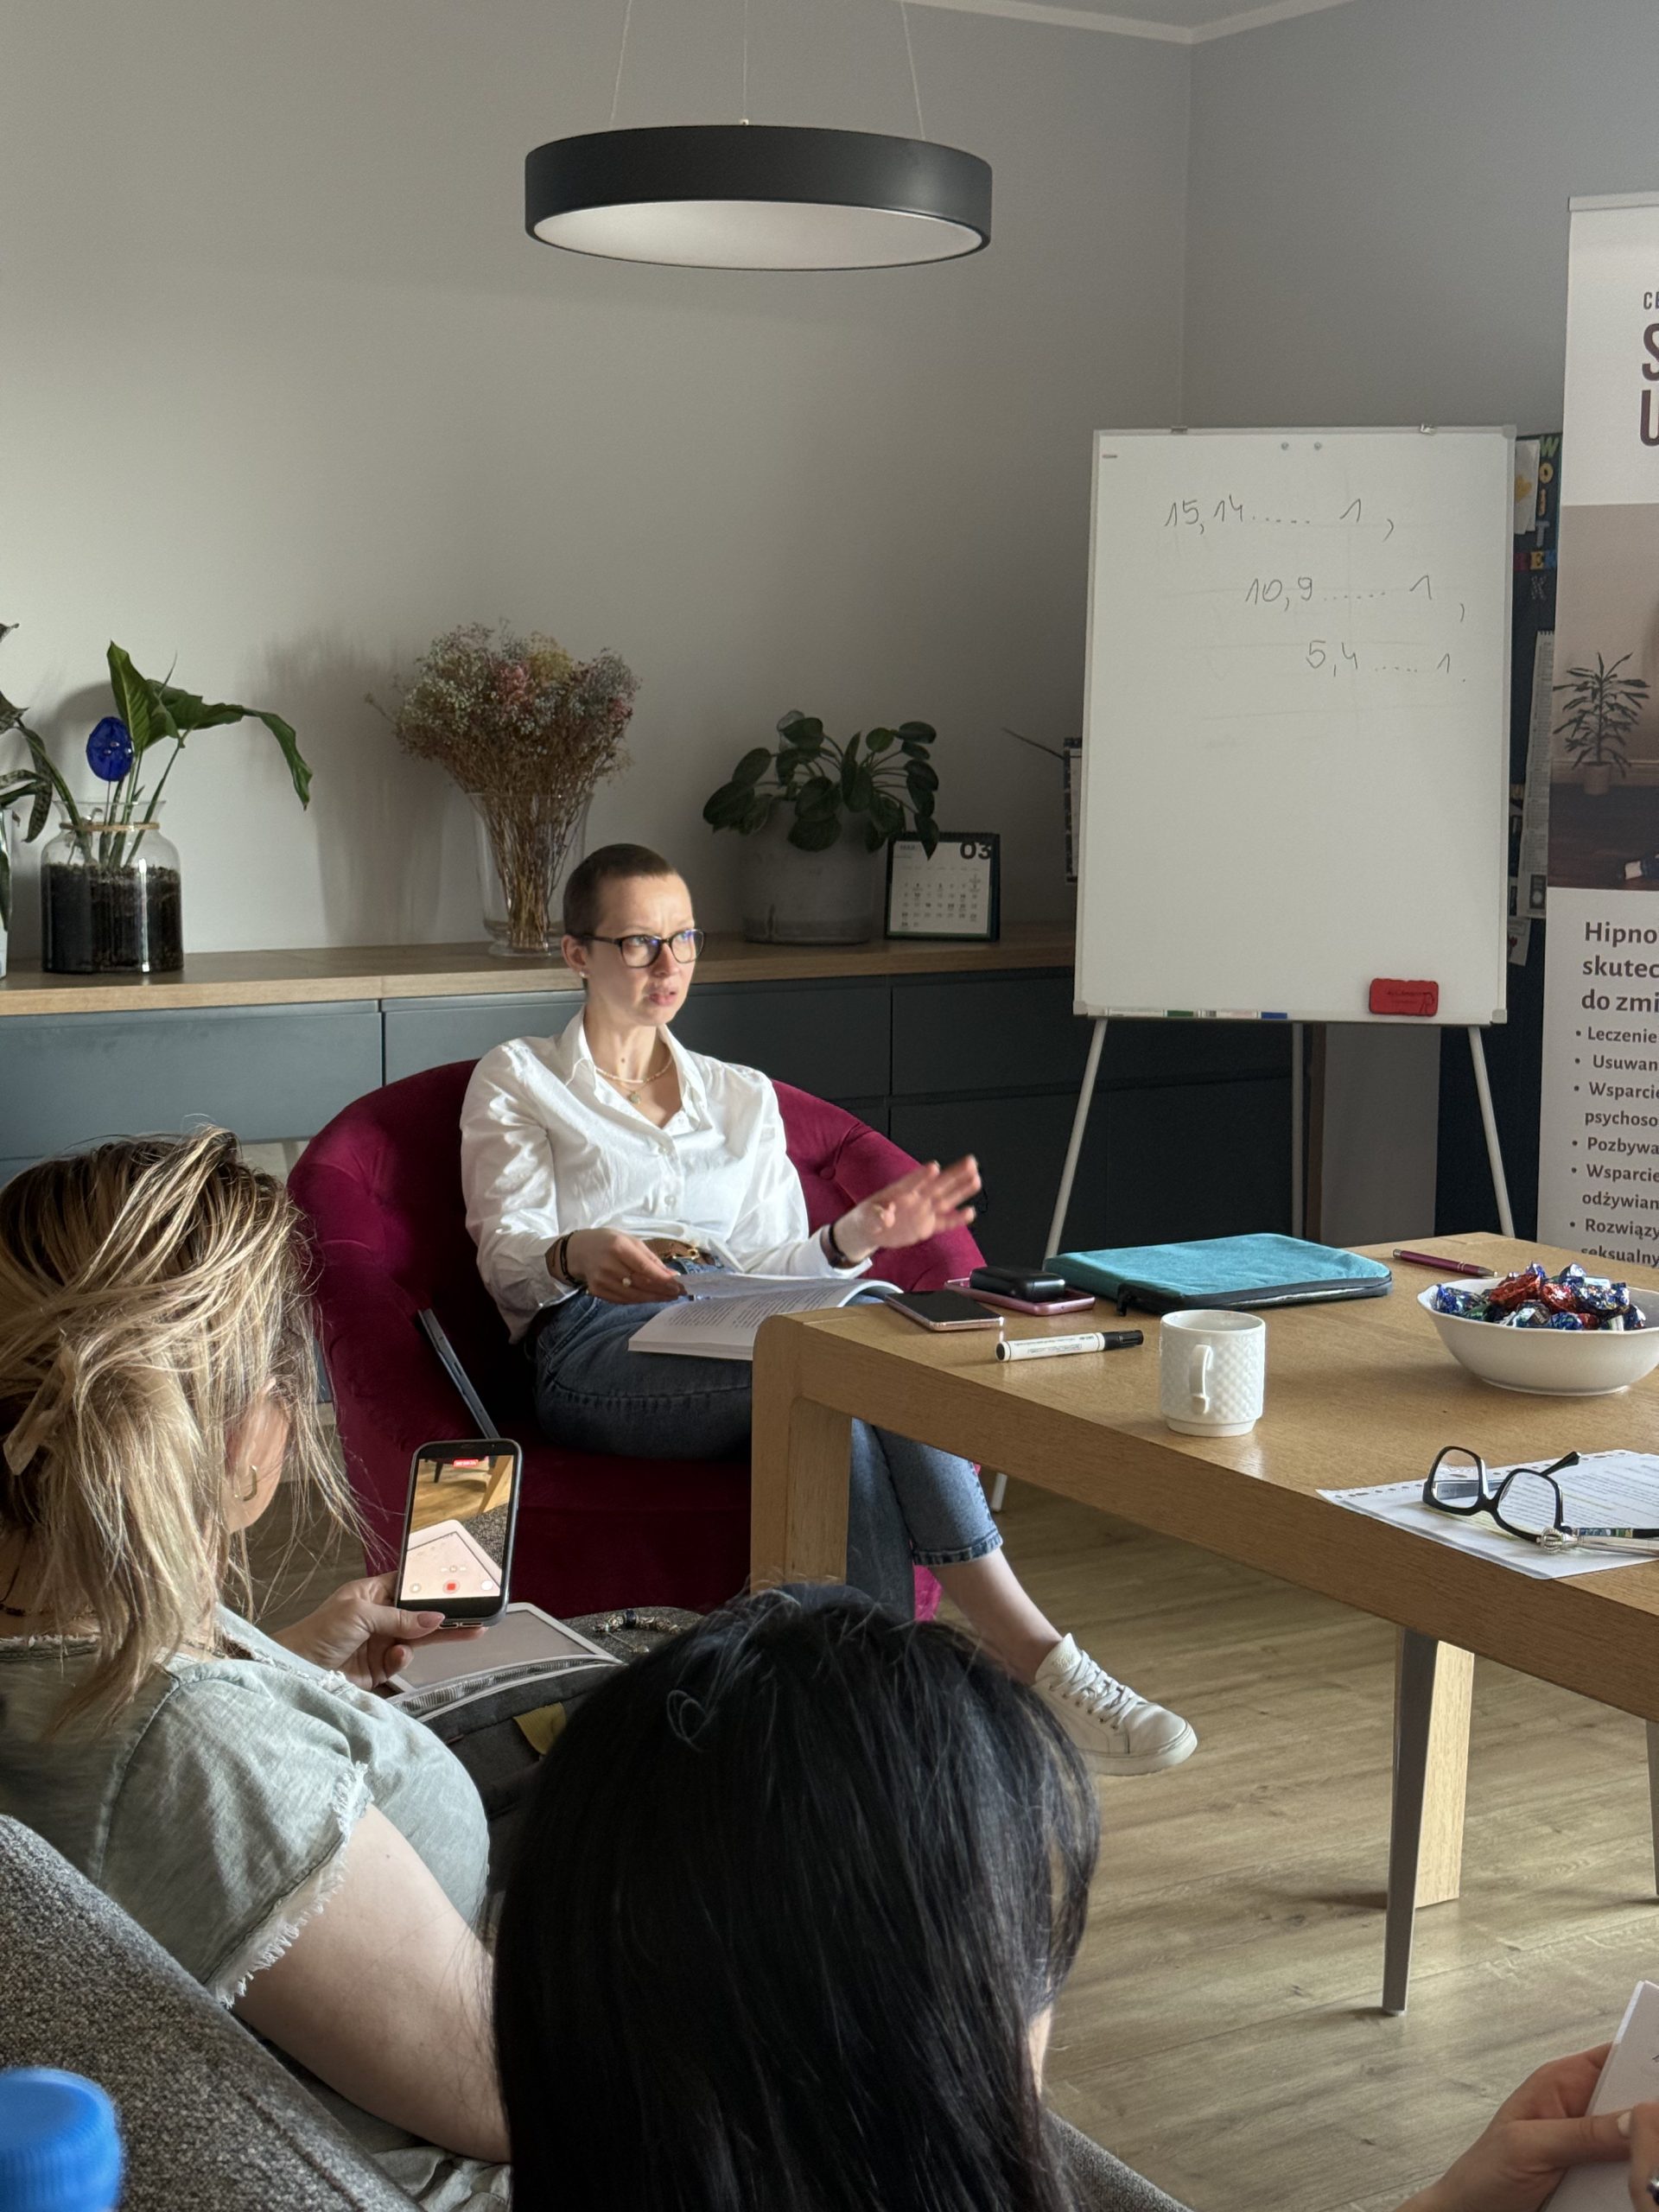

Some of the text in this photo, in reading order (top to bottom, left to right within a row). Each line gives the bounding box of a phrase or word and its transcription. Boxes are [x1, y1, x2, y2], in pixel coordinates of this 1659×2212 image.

[1585, 921, 1658, 948] Hipno
[1582, 955, 1659, 979] skutec
[1581, 988, 1659, 1014] do zmi
[1587, 1026, 1659, 1044] Leczenie
[1592, 1053, 1659, 1072] Usuwan
[1584, 1109, 1659, 1128] psychoso
[1586, 1163, 1659, 1183] Wsparcie
